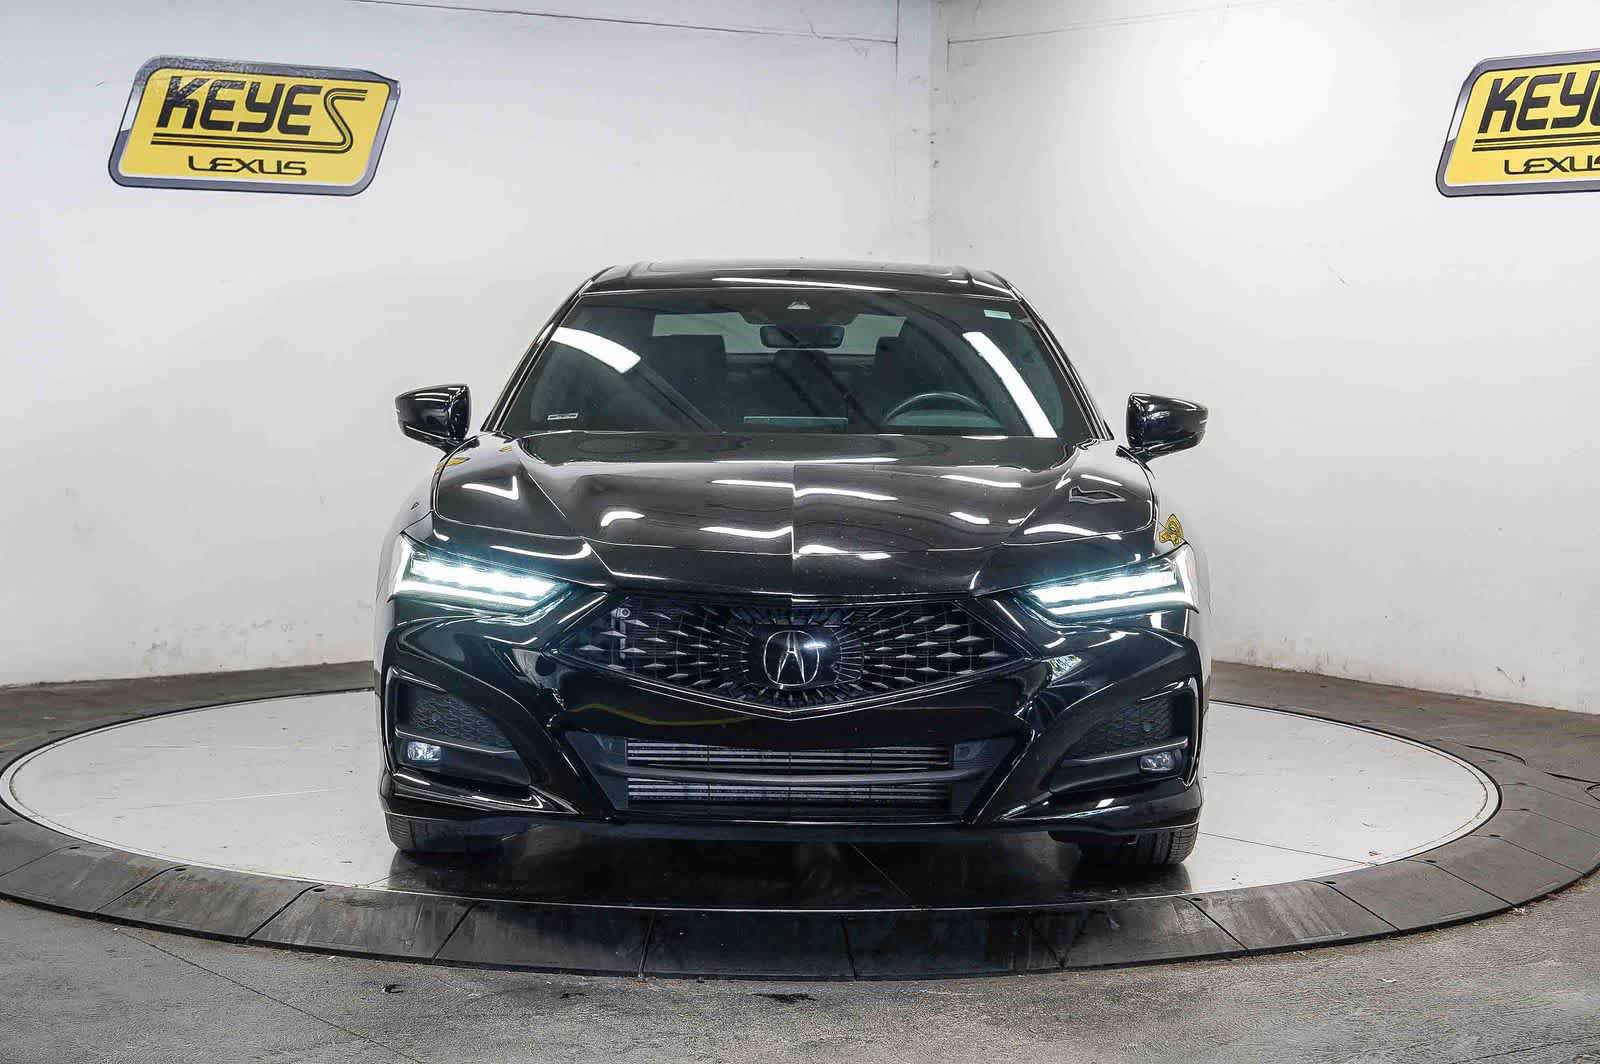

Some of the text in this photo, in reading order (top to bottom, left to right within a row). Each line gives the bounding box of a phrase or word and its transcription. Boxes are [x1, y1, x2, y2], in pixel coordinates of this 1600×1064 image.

[154, 75, 368, 153] KEYES
[1477, 70, 1600, 134] KEY
[188, 155, 307, 176] LEXUS
[1504, 155, 1600, 175] LEXU
